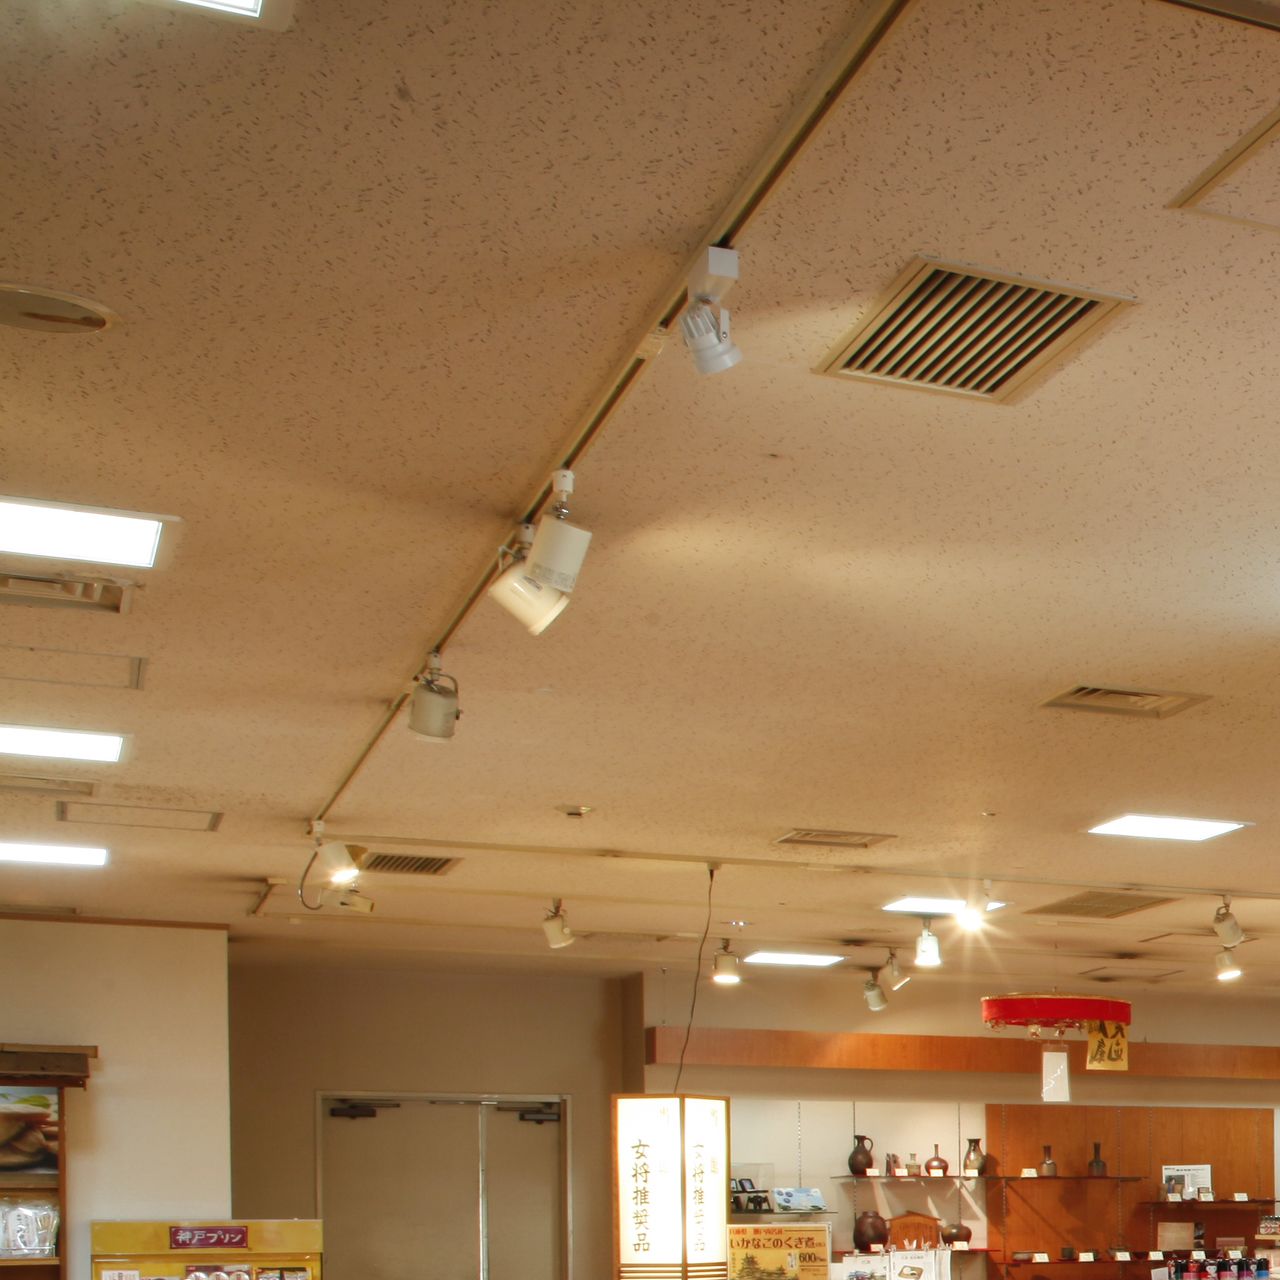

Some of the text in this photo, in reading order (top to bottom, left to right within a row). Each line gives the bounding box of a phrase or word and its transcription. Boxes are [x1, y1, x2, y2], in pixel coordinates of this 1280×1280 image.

[631, 1139, 651, 1252] 女将推奨品
[176, 1230, 242, 1244] 神戸プリン
